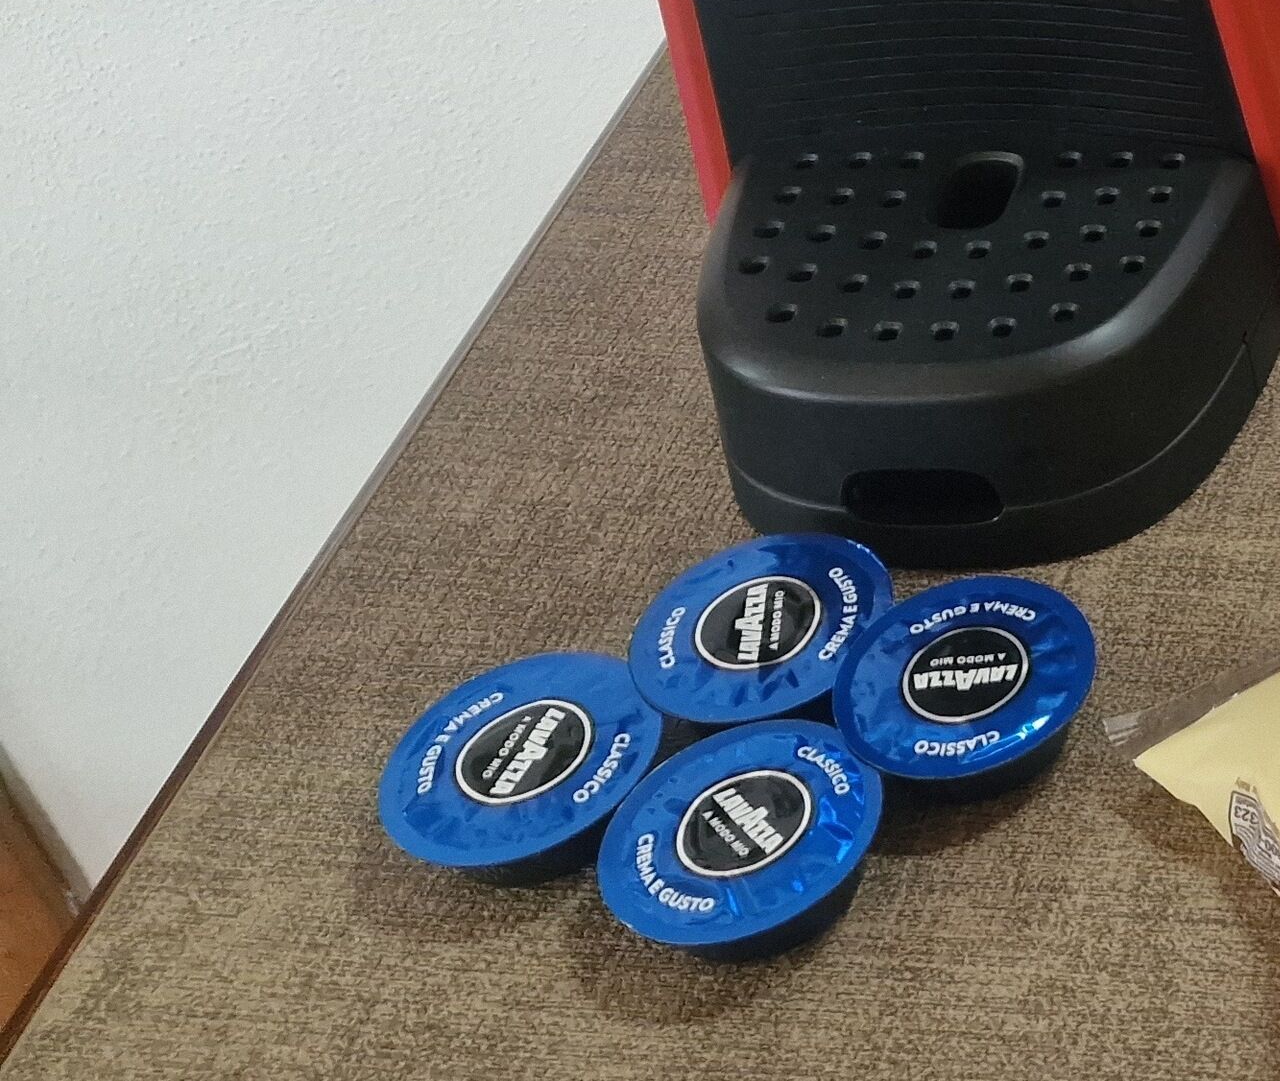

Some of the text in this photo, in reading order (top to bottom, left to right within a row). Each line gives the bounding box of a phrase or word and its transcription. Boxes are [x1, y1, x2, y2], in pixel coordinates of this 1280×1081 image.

[772, 590, 785, 609] MIO
[818, 567, 858, 661] CREMA E GUSTO
[735, 583, 769, 662] LAVAZZA
[770, 610, 783, 639] MODO
[910, 600, 1037, 635] CREMA E GUSTO
[658, 607, 686, 669] CLASSICO
[930, 656, 954, 667] MIO
[957, 654, 995, 664] MODO
[913, 664, 1019, 691] LAVAZZA
[417, 692, 504, 794] CREMA E GUSTO
[489, 707, 566, 795] LAVAZZA
[498, 722, 527, 757] MODO
[914, 730, 1000, 756] CLASSICO
[482, 757, 502, 779] MIO
[573, 733, 631, 803] CLASSICO
[797, 745, 851, 796] CLASSICO
[709, 816, 735, 842] MODO
[712, 787, 785, 855] LAVAZZA
[636, 833, 716, 913] CREMA E GUSTO
